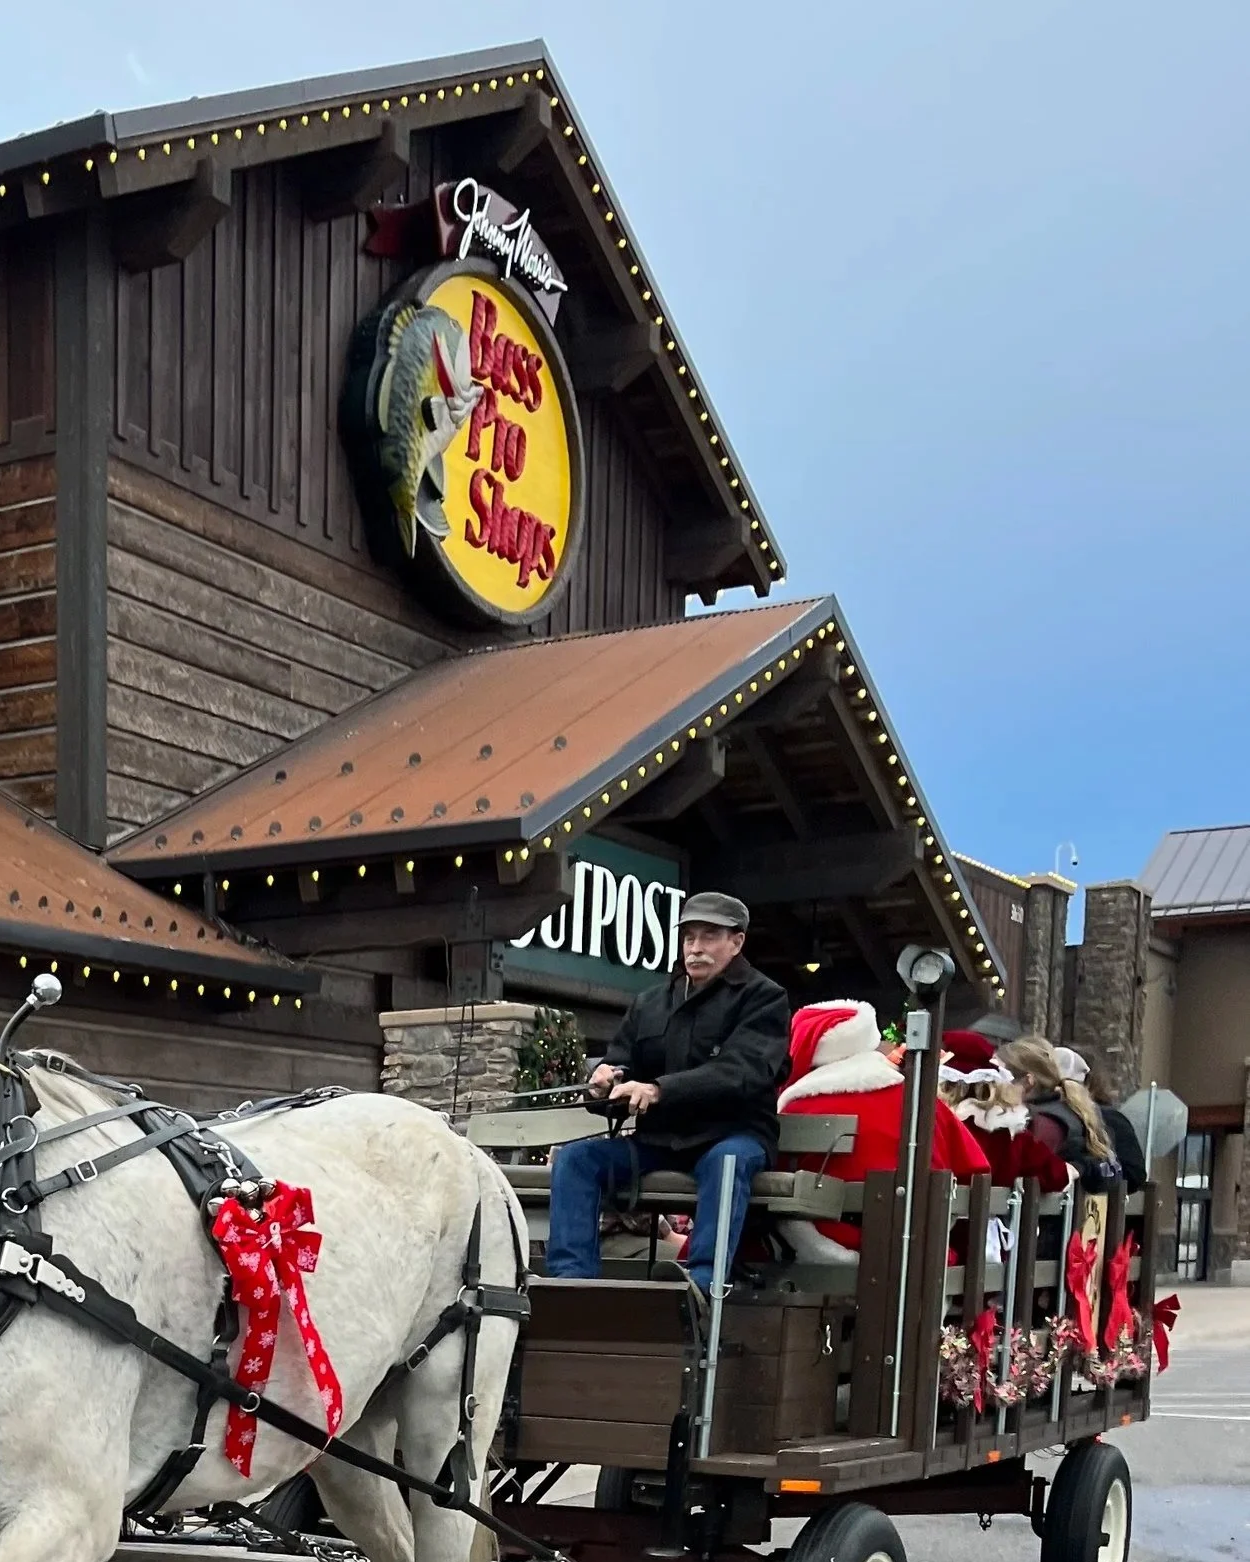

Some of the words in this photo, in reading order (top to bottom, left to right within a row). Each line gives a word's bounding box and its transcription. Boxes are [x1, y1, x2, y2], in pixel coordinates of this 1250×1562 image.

[454, 177, 516, 279] Johnny
[501, 207, 568, 291] Morris
[470, 290, 543, 413] Bass
[465, 380, 527, 482] Pro
[465, 467, 556, 588] Shops
[510, 860, 686, 973] TPOST
